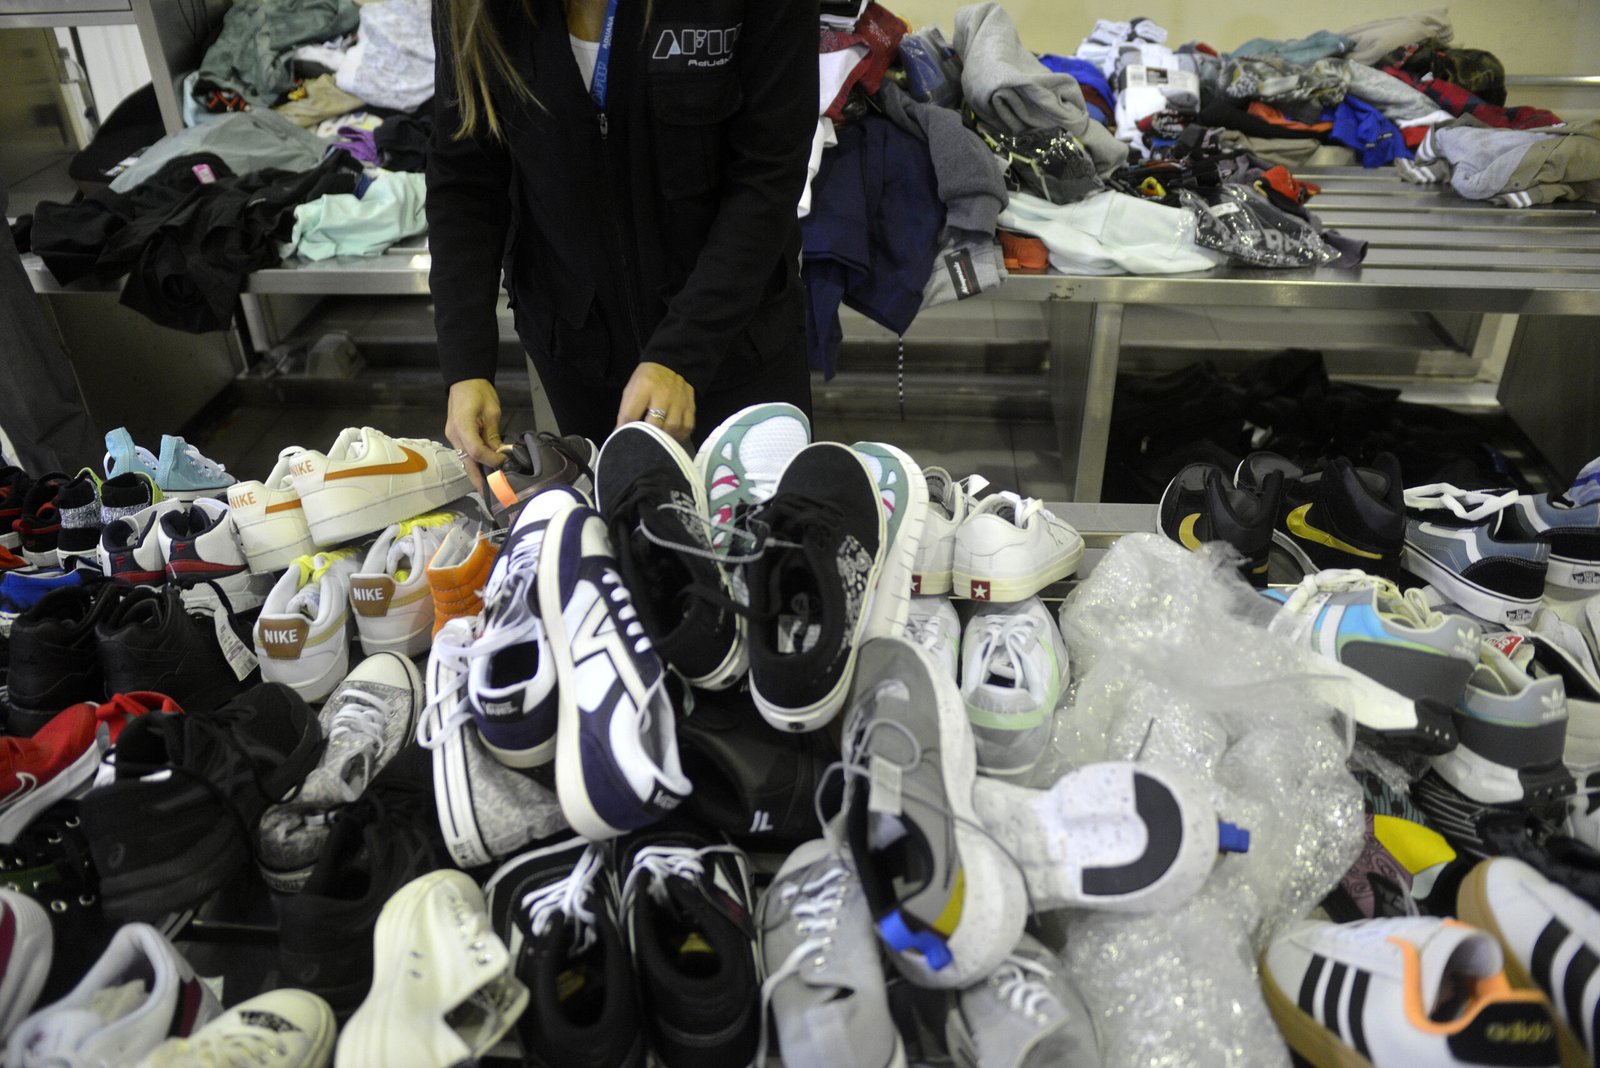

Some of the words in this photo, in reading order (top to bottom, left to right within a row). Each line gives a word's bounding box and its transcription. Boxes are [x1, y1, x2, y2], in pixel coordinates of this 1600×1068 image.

[290, 459, 315, 478] NIKE
[229, 491, 257, 510] NIKE
[353, 587, 384, 601] NIKE
[263, 628, 299, 644] NIKE
